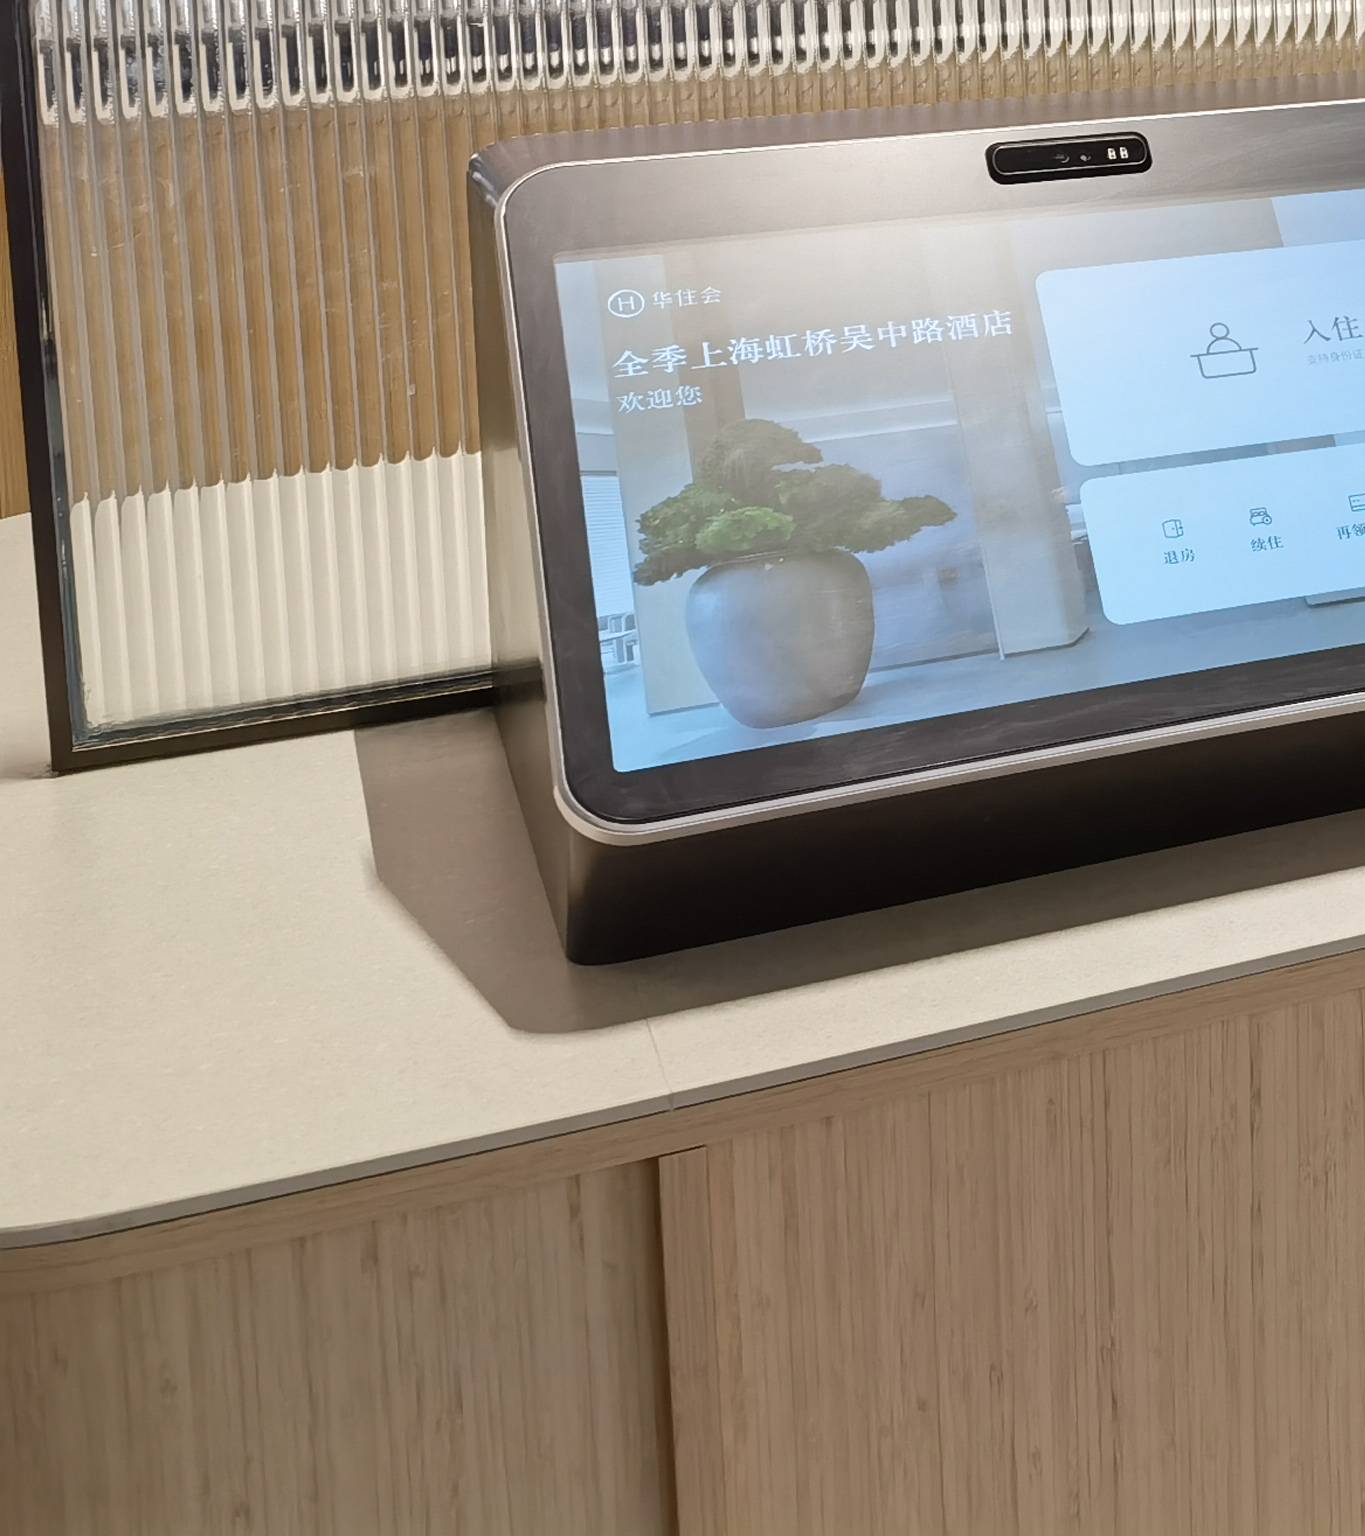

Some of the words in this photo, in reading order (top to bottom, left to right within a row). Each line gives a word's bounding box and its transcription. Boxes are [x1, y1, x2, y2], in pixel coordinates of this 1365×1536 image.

[652, 286, 721, 309] 华住会
[1304, 315, 1364, 344] 入住
[612, 309, 1013, 378] 全季上海虹桥吴中路酒店
[616, 385, 703, 413] 欢迎您
[1164, 548, 1195, 564] 退房
[1250, 535, 1284, 552] 续住
